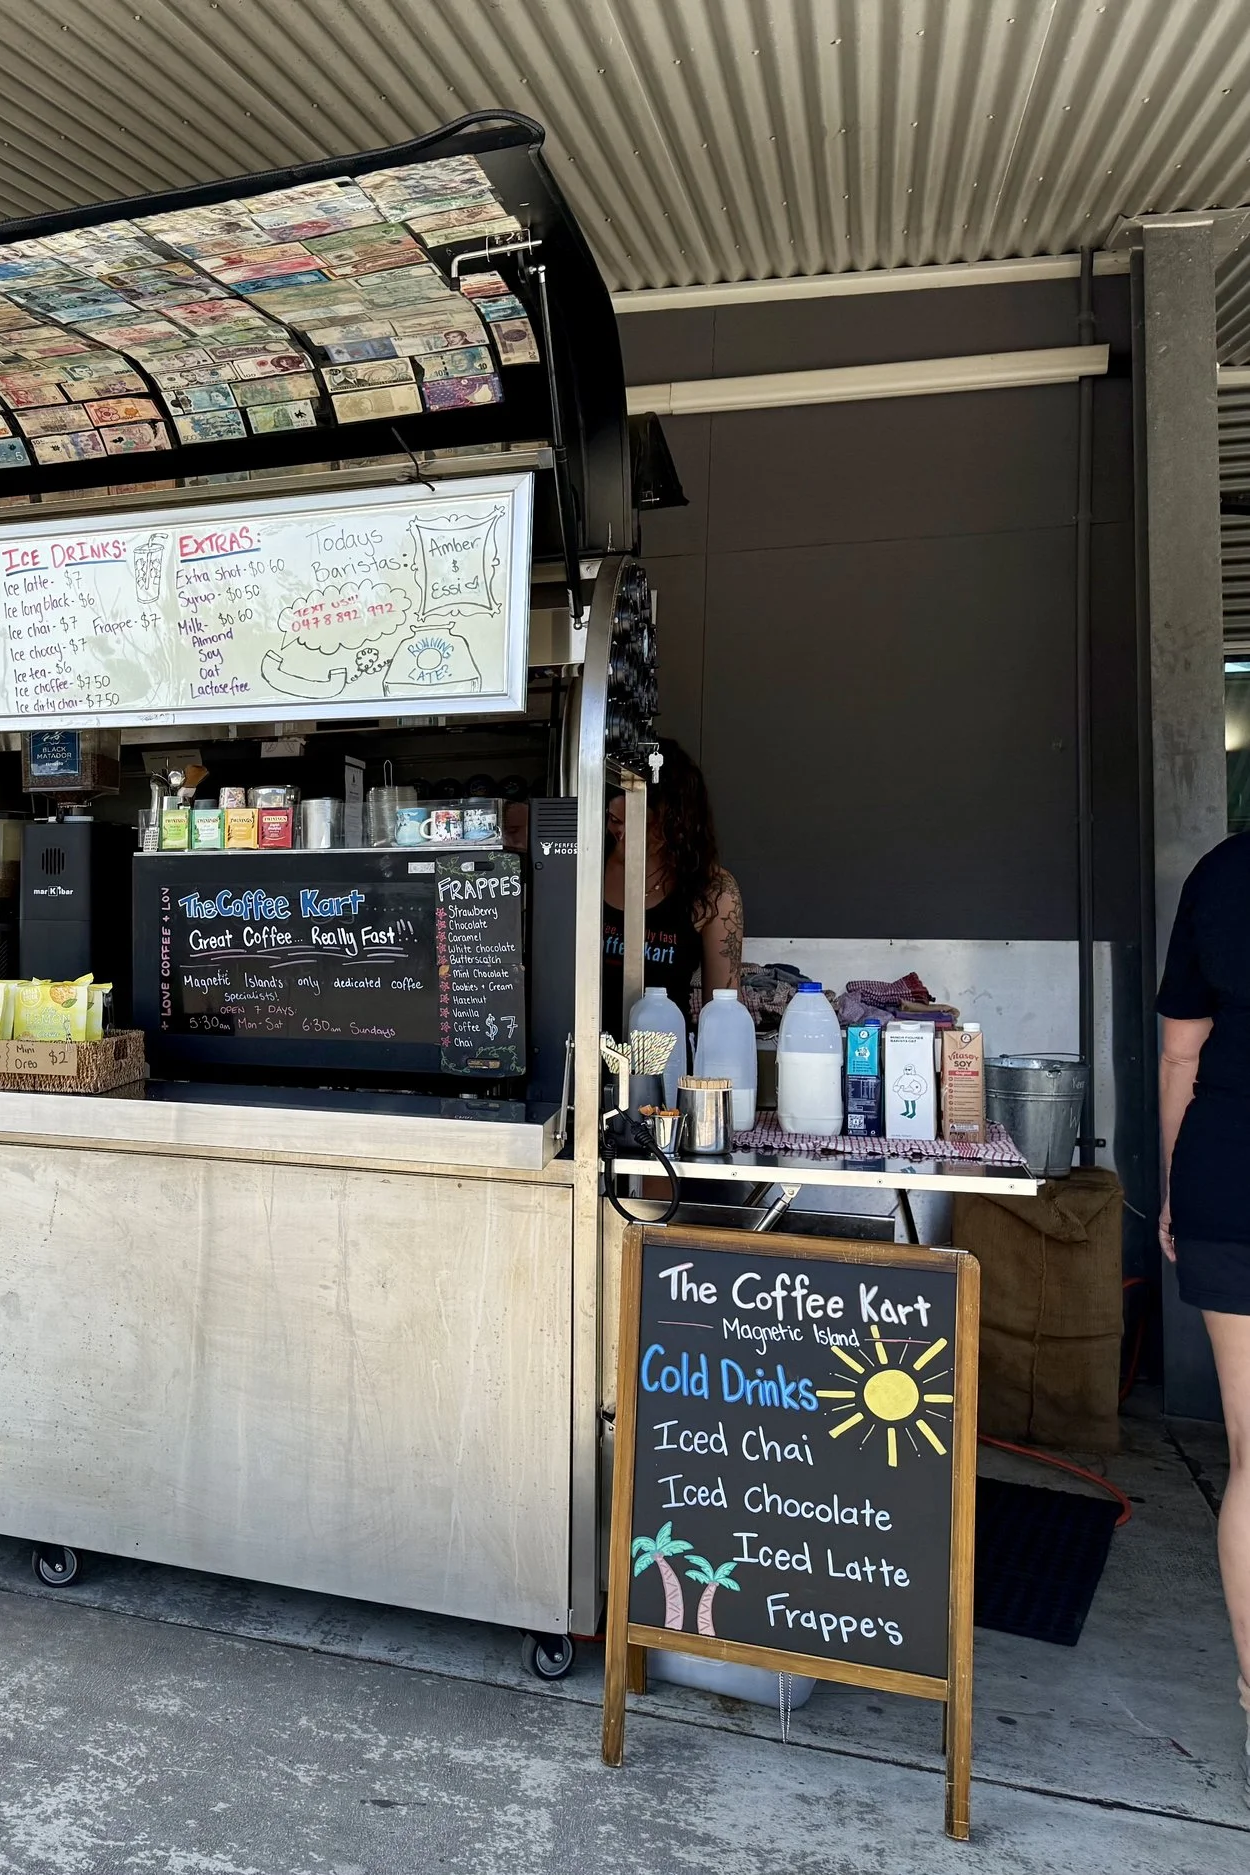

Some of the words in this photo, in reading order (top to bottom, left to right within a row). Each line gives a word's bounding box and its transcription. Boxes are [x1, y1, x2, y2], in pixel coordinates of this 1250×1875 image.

[15, 451, 24, 461] 5
[306, 525, 383, 554] Todays
[428, 536, 481, 557] Amber
[2, 548, 40, 572] ICE
[4, 581, 20, 597] Ice
[64, 570, 82, 589] $7
[176, 568, 210, 589] Extra
[4, 602, 20, 619] Ice
[21, 600, 42, 623] long
[78, 592, 95, 609] $6
[293, 603, 326, 618] TEXT
[367, 602, 396, 617] 992
[8, 625, 23, 640] Ice
[59, 616, 78, 633] $7
[140, 612, 162, 632] $7
[192, 627, 233, 648] Almond
[10, 648, 25, 662] Ice
[69, 638, 88, 655] $7
[199, 649, 224, 665] Soy
[13, 669, 28, 684] Ice
[55, 661, 72, 675] $6
[200, 665, 221, 680] Oat
[437, 875, 522, 902] FRAPPES
[449, 905, 498, 920] Strawberry
[449, 919, 488, 930] Chocolate
[190, 929, 233, 950] Great
[311, 926, 358, 956] Really
[448, 932, 482, 942] Caramel
[184, 970, 230, 995] Magnetic
[298, 977, 321, 996] only
[333, 977, 381, 989] dedicated
[391, 977, 423, 991] coffee
[473, 968, 510, 978] Chocolate
[452, 982, 479, 992] Cookies
[488, 982, 514, 991] Cream
[452, 995, 487, 1004] Hazelnut
[220, 1006, 245, 1014] OPEN
[255, 1006, 262, 1015] 7
[452, 1008, 480, 1018] Vanilla
[350, 1022, 396, 1038] Sundays
[453, 1022, 481, 1032] Coffee
[16, 1043, 36, 1054] Mini
[454, 1037, 473, 1047] Chai
[14, 1057, 38, 1070] Oreo
[48, 1050, 69, 1065] $2
[658, 1262, 718, 1305] The
[731, 1272, 845, 1322] Coffee
[858, 1282, 931, 1327] Kart
[722, 1317, 804, 1356] Magnetic
[813, 1322, 860, 1347] Island
[641, 1344, 710, 1400] Cold
[720, 1357, 820, 1413] Drinks
[653, 1419, 729, 1457] Iced
[741, 1425, 815, 1467] Chai
[657, 1473, 728, 1510] Iced
[744, 1482, 893, 1532] Chocolate
[732, 1531, 813, 1575] Iced
[827, 1548, 911, 1589] Latte
[765, 1592, 904, 1647] Frappe's
